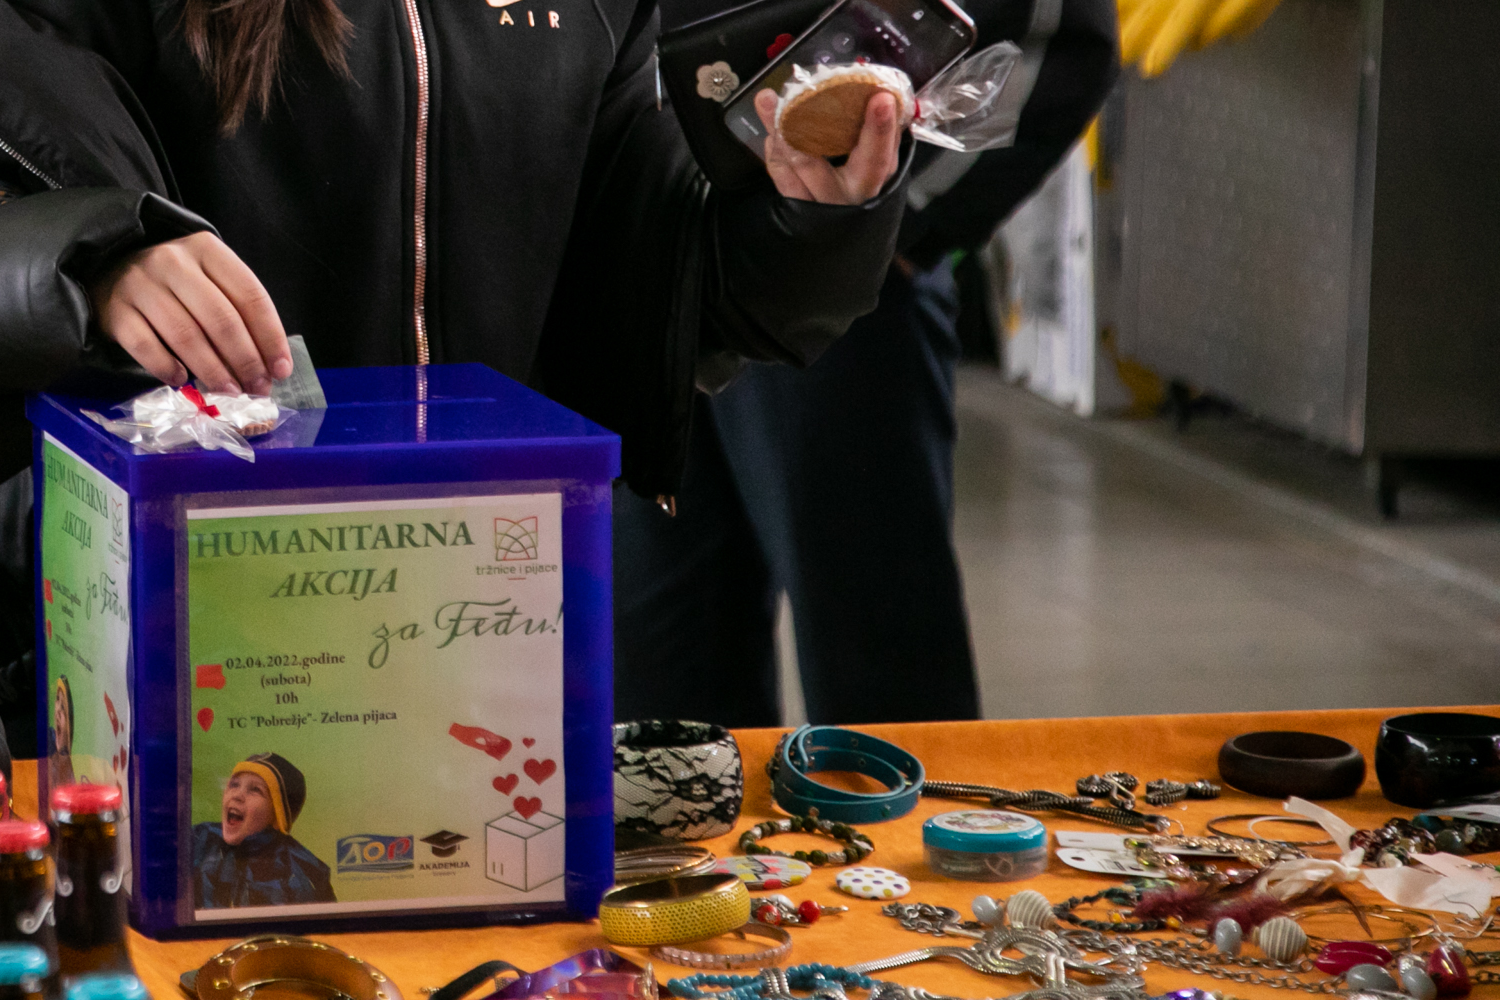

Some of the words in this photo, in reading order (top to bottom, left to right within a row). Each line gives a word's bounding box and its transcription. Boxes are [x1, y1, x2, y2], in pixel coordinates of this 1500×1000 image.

[499, 9, 560, 29] AIR
[47, 454, 109, 519] HUMANITARNA
[61, 510, 92, 550] AKCIJA
[197, 520, 475, 558] HUMANITARNA
[476, 564, 516, 575] tržnice
[524, 564, 558, 575] pijace
[269, 567, 400, 601] AKCIJA
[367, 622, 426, 669] za
[434, 598, 563, 649] Feđu!
[225, 652, 346, 670] 02.04.2022.godine
[260, 671, 312, 689] (subota)
[275, 692, 299, 705] 10h
[227, 716, 247, 729] TC
[320, 710, 360, 725] Zelena
[362, 709, 397, 725] pijaca
